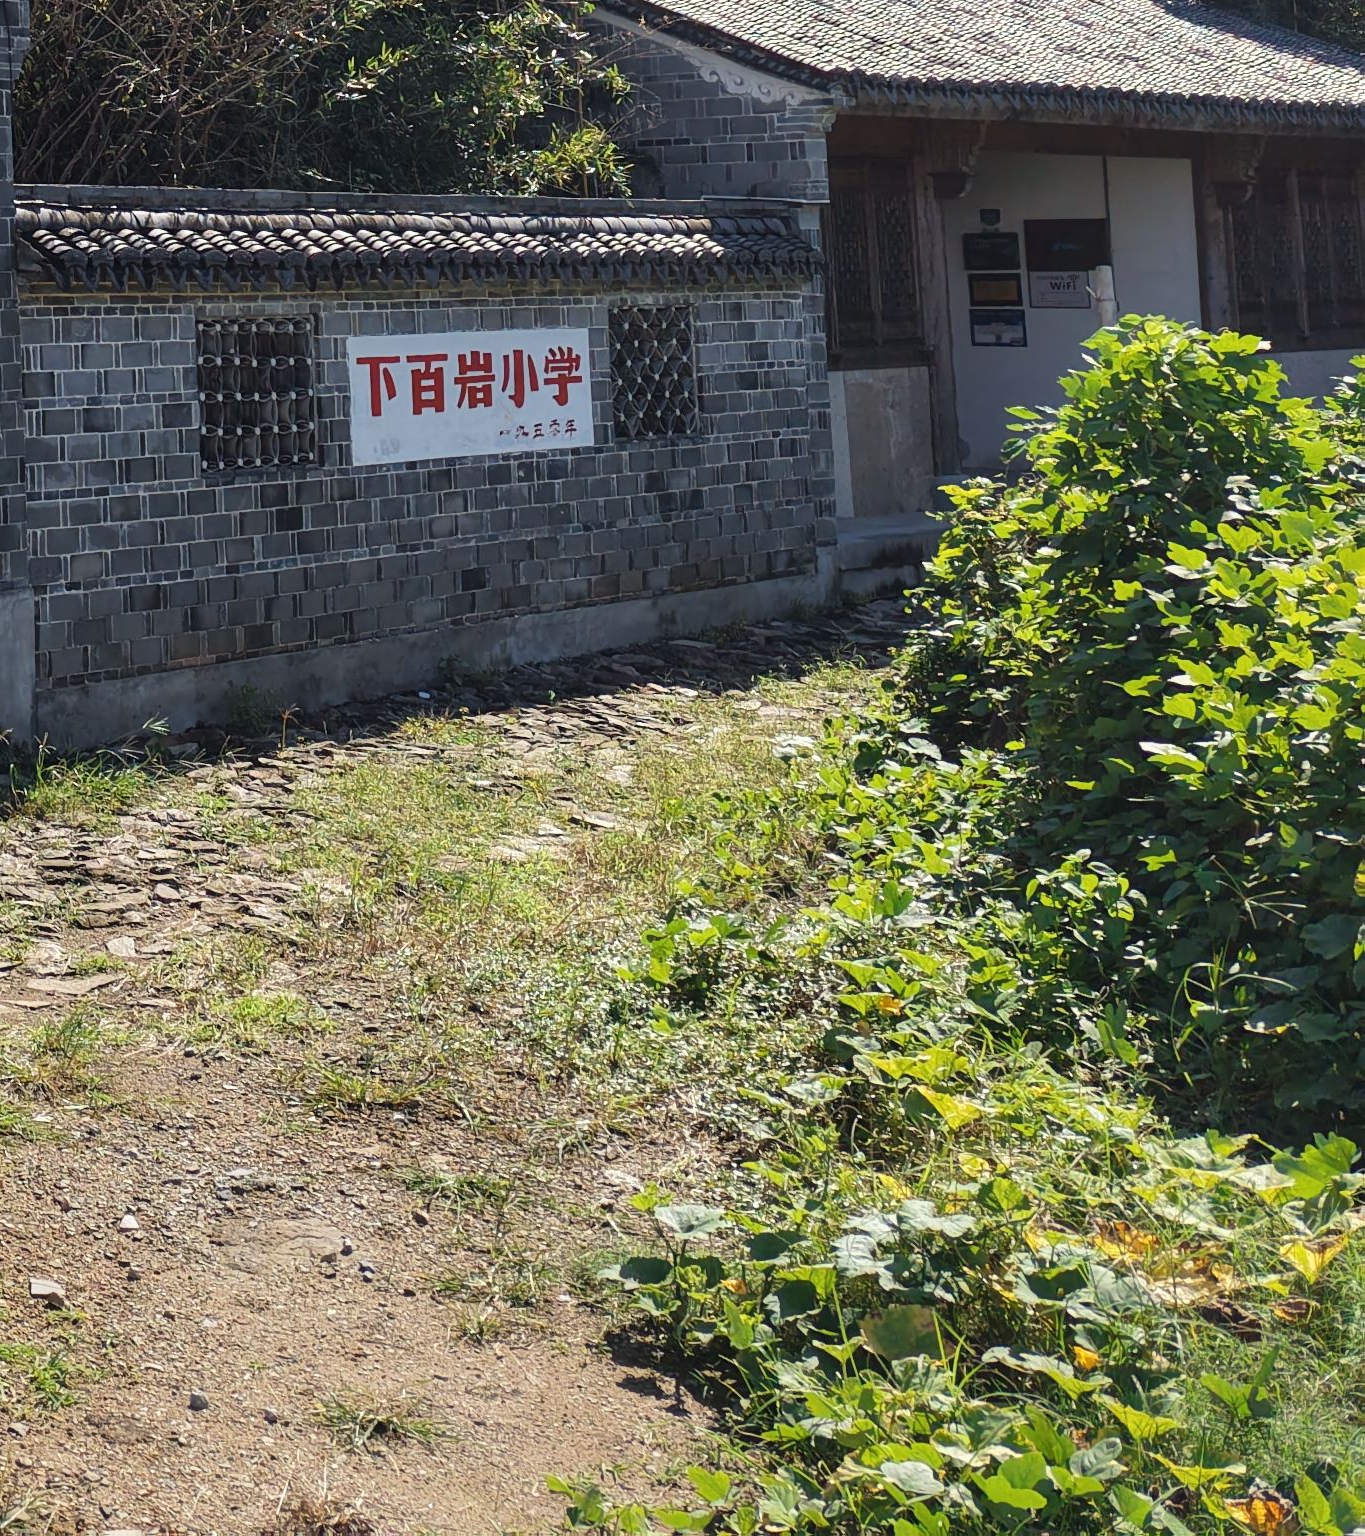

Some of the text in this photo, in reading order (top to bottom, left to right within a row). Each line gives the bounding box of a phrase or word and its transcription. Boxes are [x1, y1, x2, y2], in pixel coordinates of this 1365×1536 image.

[356, 346, 583, 417] 下百岩小学
